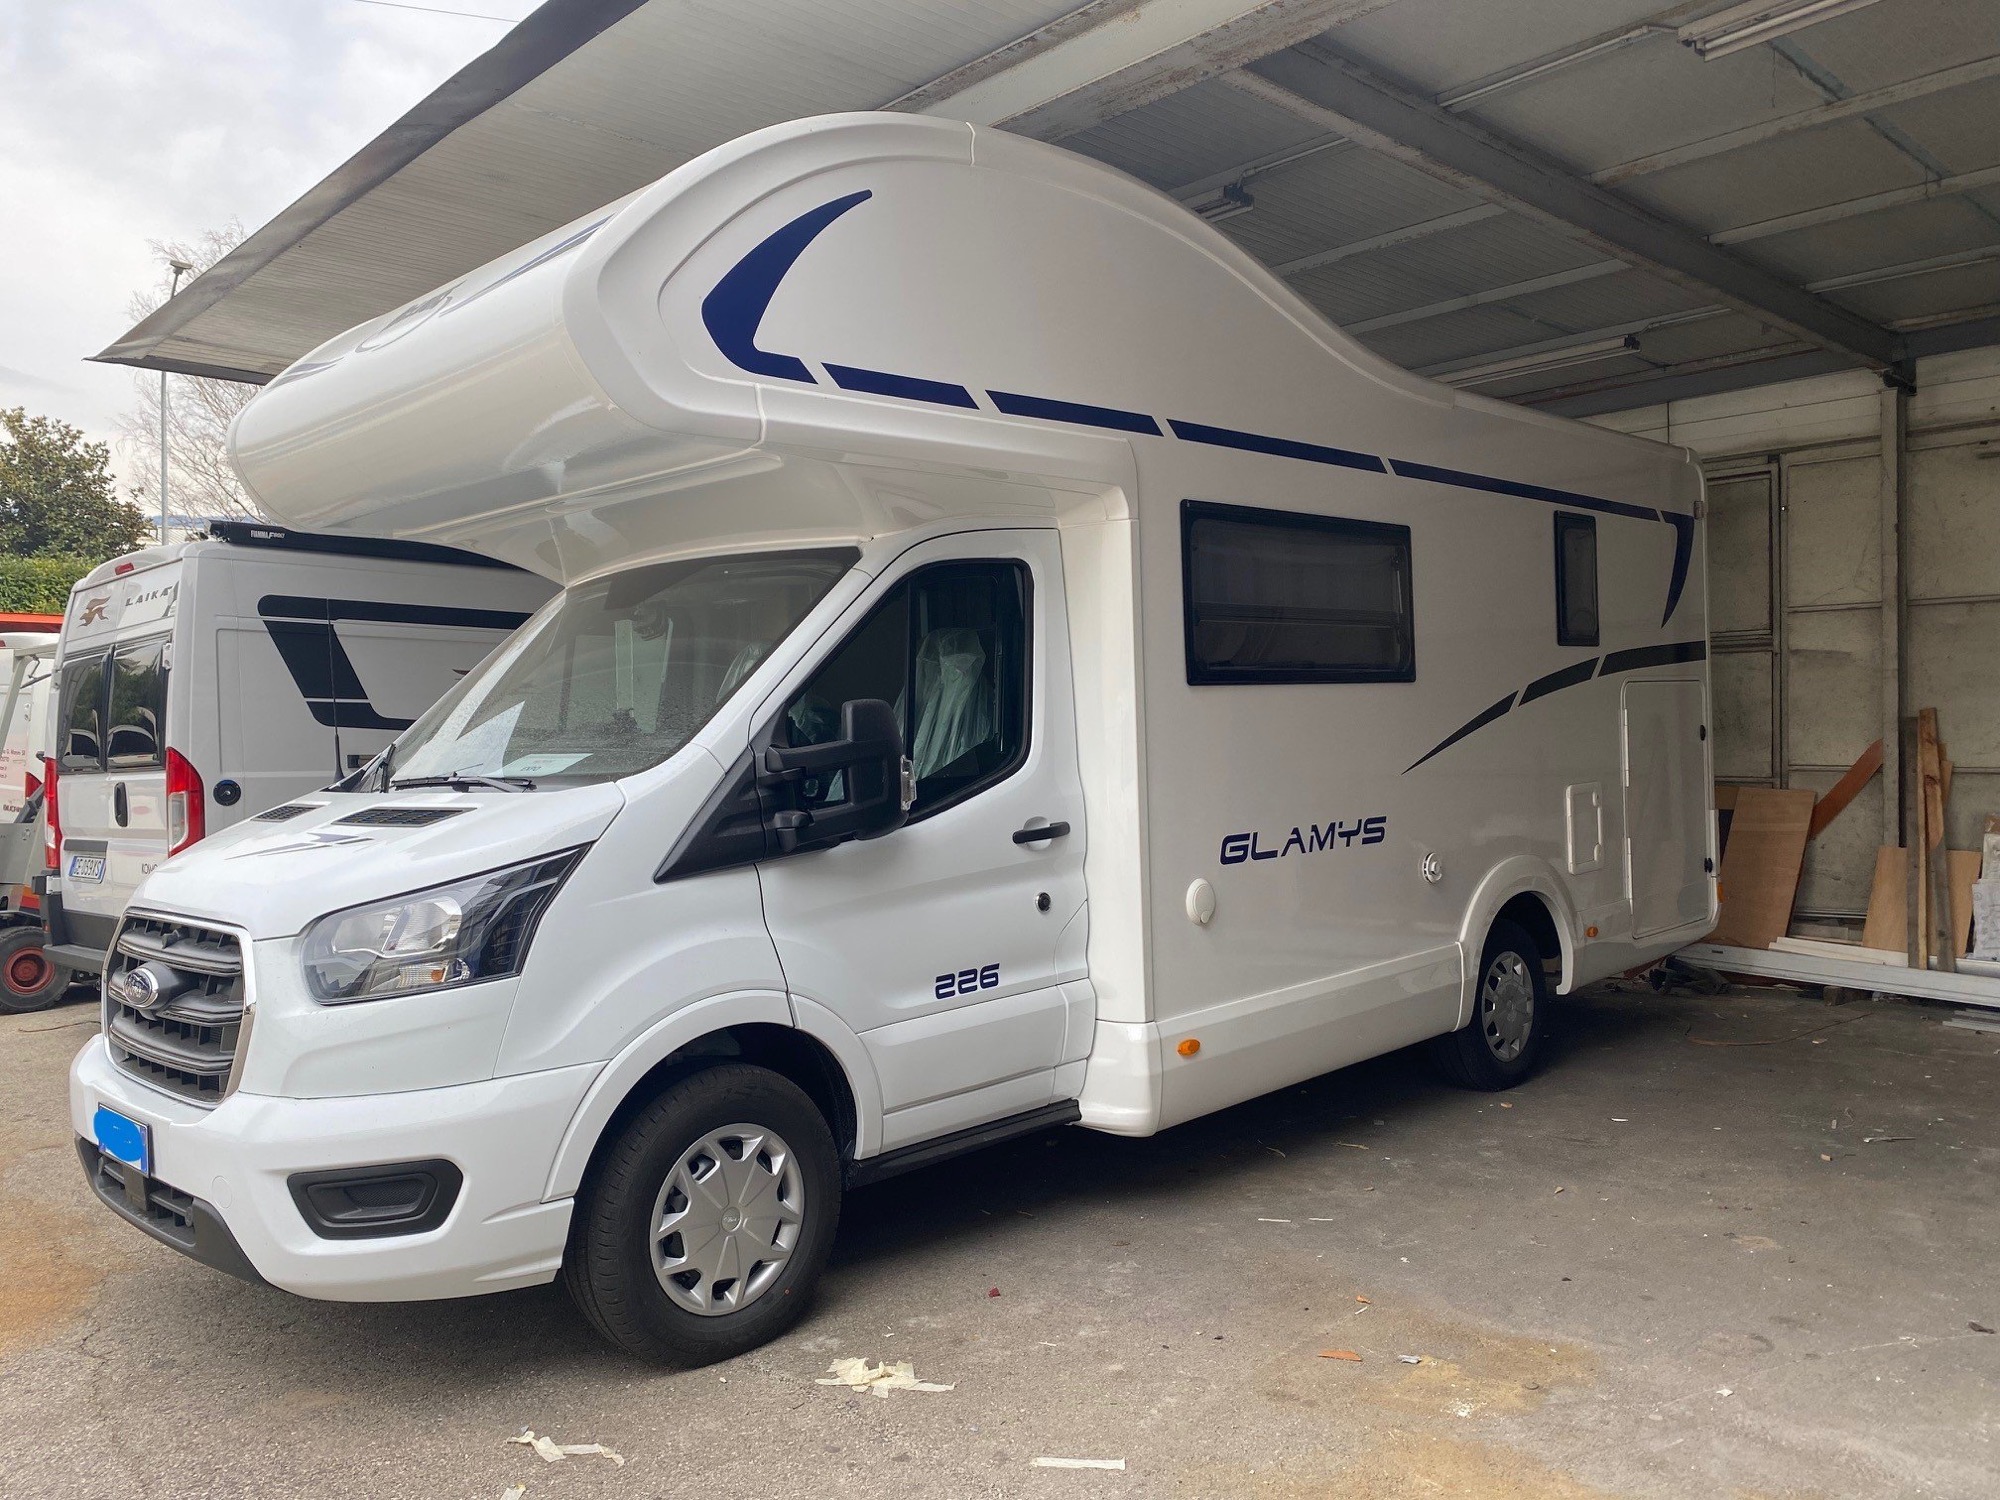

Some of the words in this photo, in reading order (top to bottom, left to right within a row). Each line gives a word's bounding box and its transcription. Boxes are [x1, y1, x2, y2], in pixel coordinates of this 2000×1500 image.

[125, 586, 171, 606] LAIKA
[1220, 816, 1387, 865] GLAMYS
[935, 963, 1000, 999] 226
